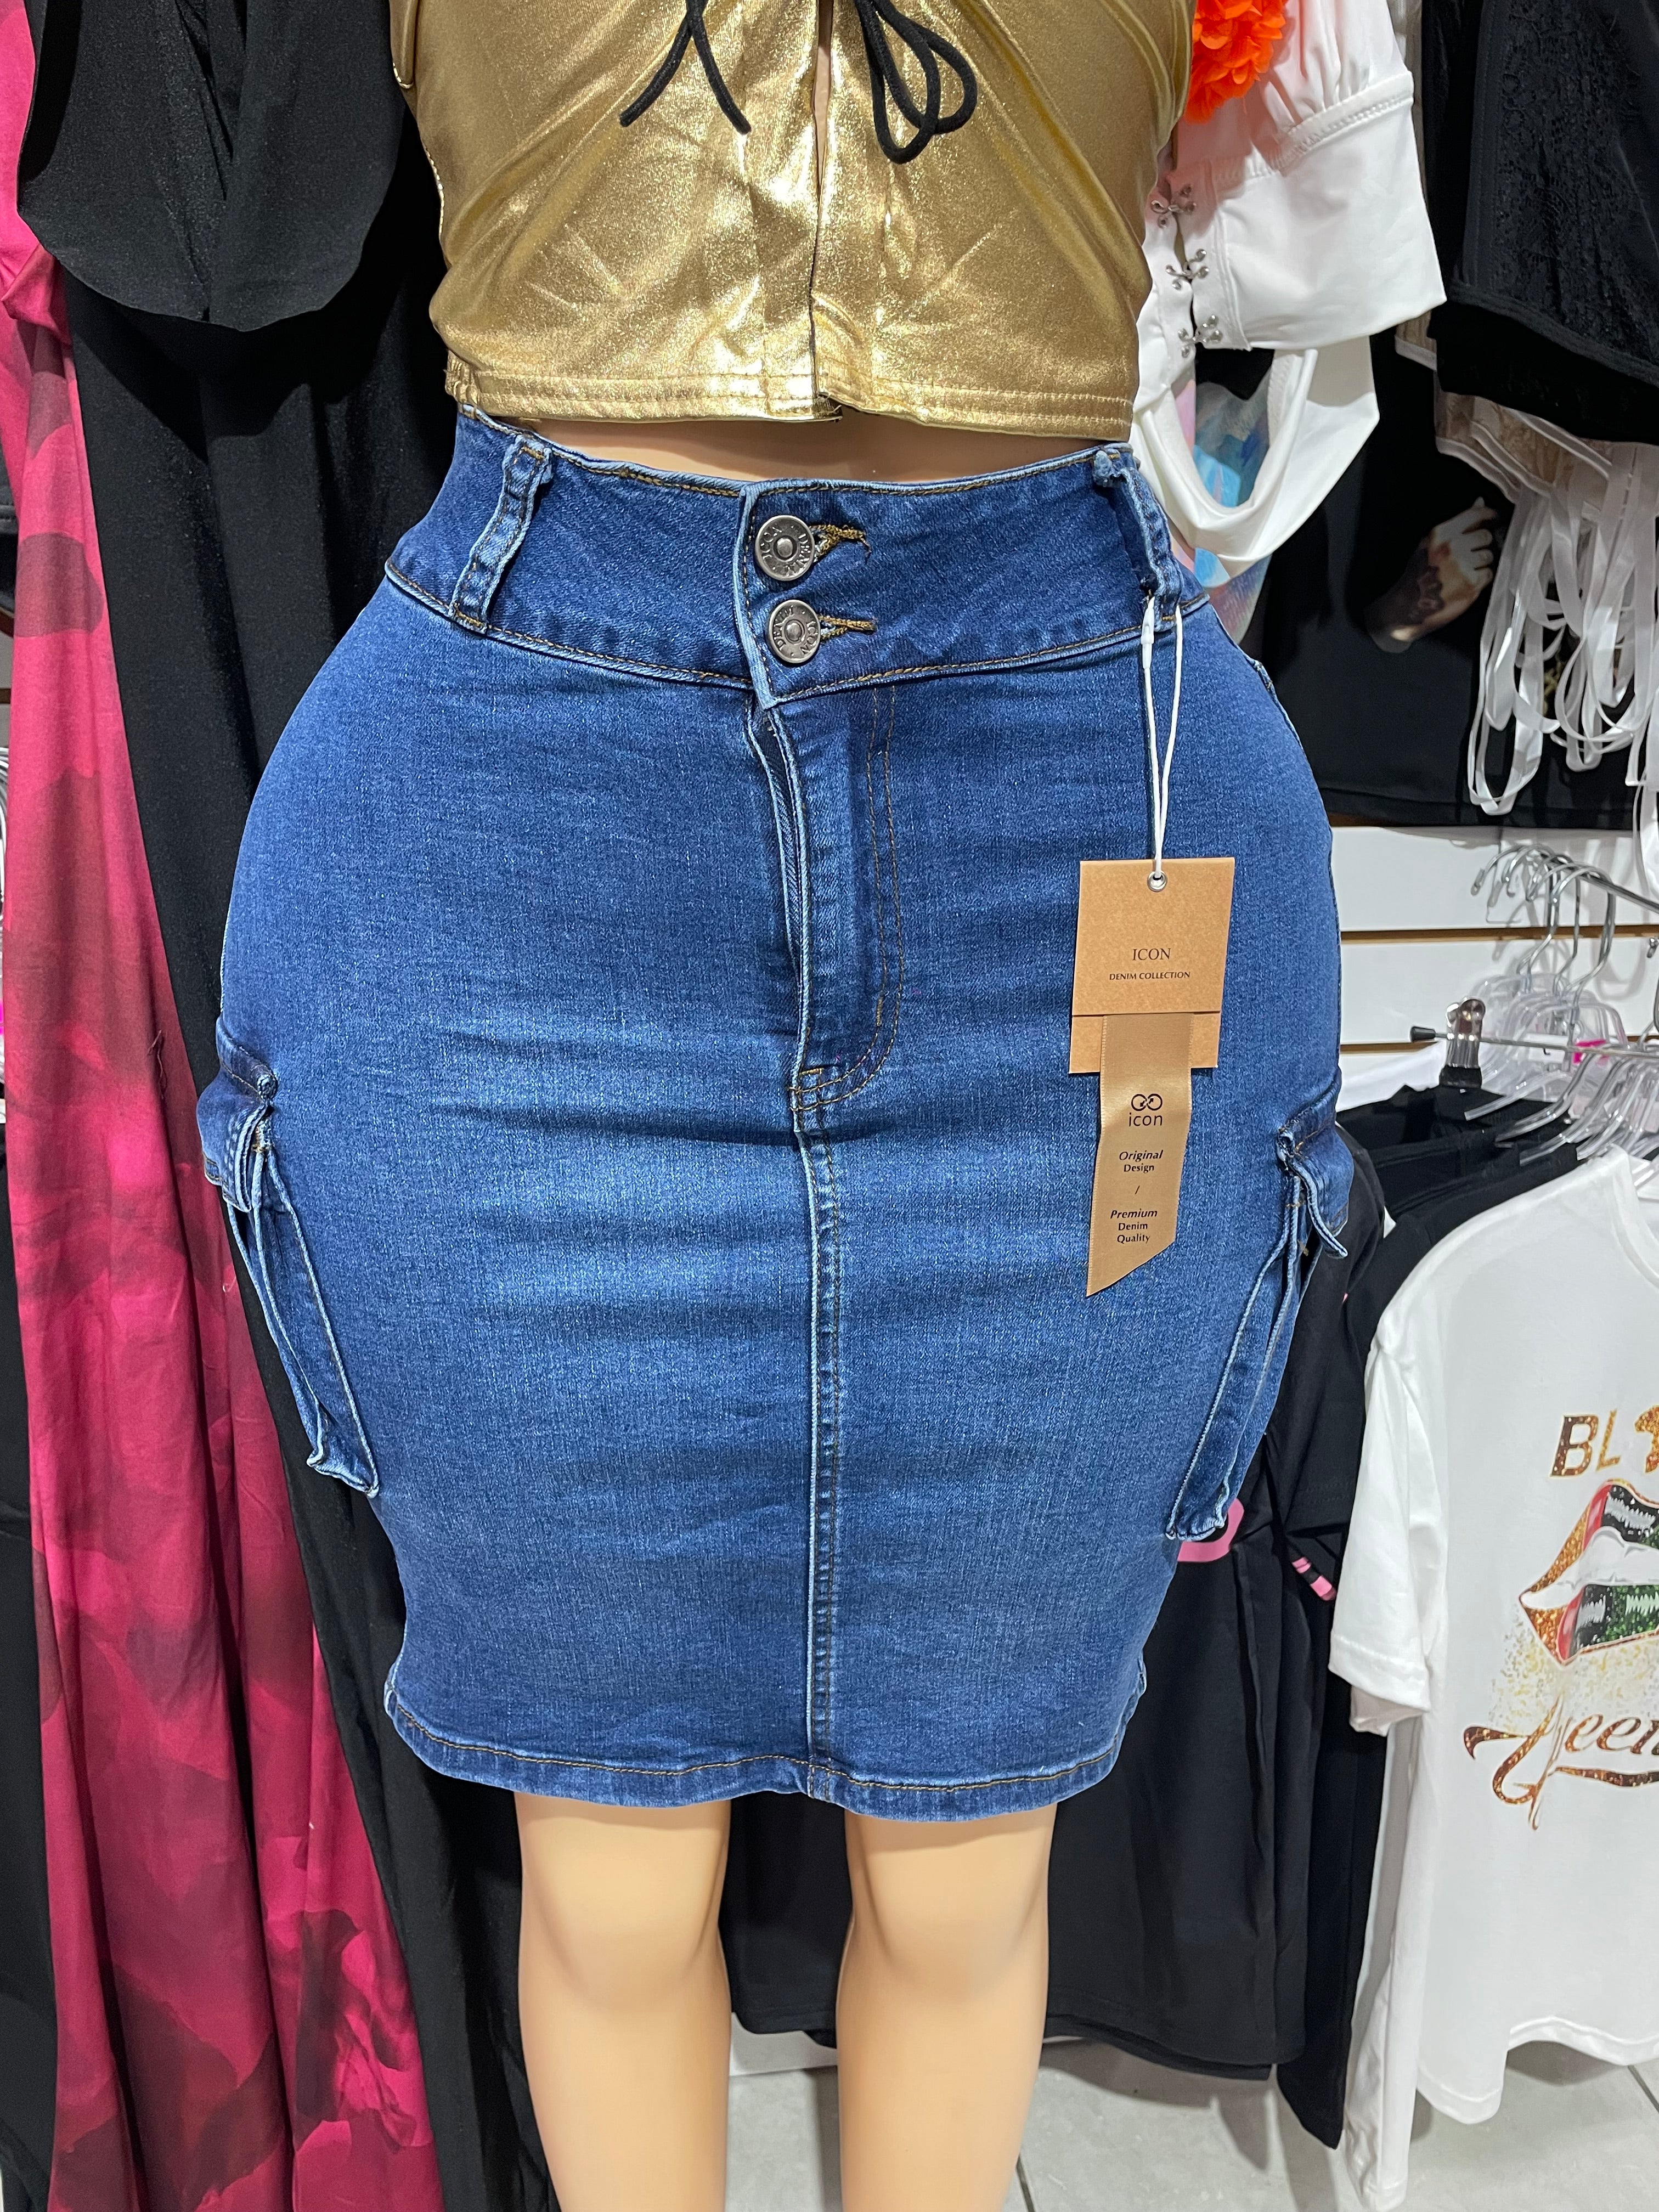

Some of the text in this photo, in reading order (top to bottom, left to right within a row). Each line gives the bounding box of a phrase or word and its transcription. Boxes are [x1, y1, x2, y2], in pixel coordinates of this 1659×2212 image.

[773, 605, 794, 651] DENIM
[800, 620, 819, 655] ICON
[1132, 947, 1171, 961] ICON
[1139, 971, 1190, 980] COLLECTION
[1128, 1112, 1163, 1127] icon
[1119, 1149, 1164, 1163] Original
[1124, 1163, 1154, 1174] Design
[1110, 1208, 1158, 1219] Premium
[1118, 1221, 1148, 1231] Denim
[1117, 1233, 1150, 1244] Quality
